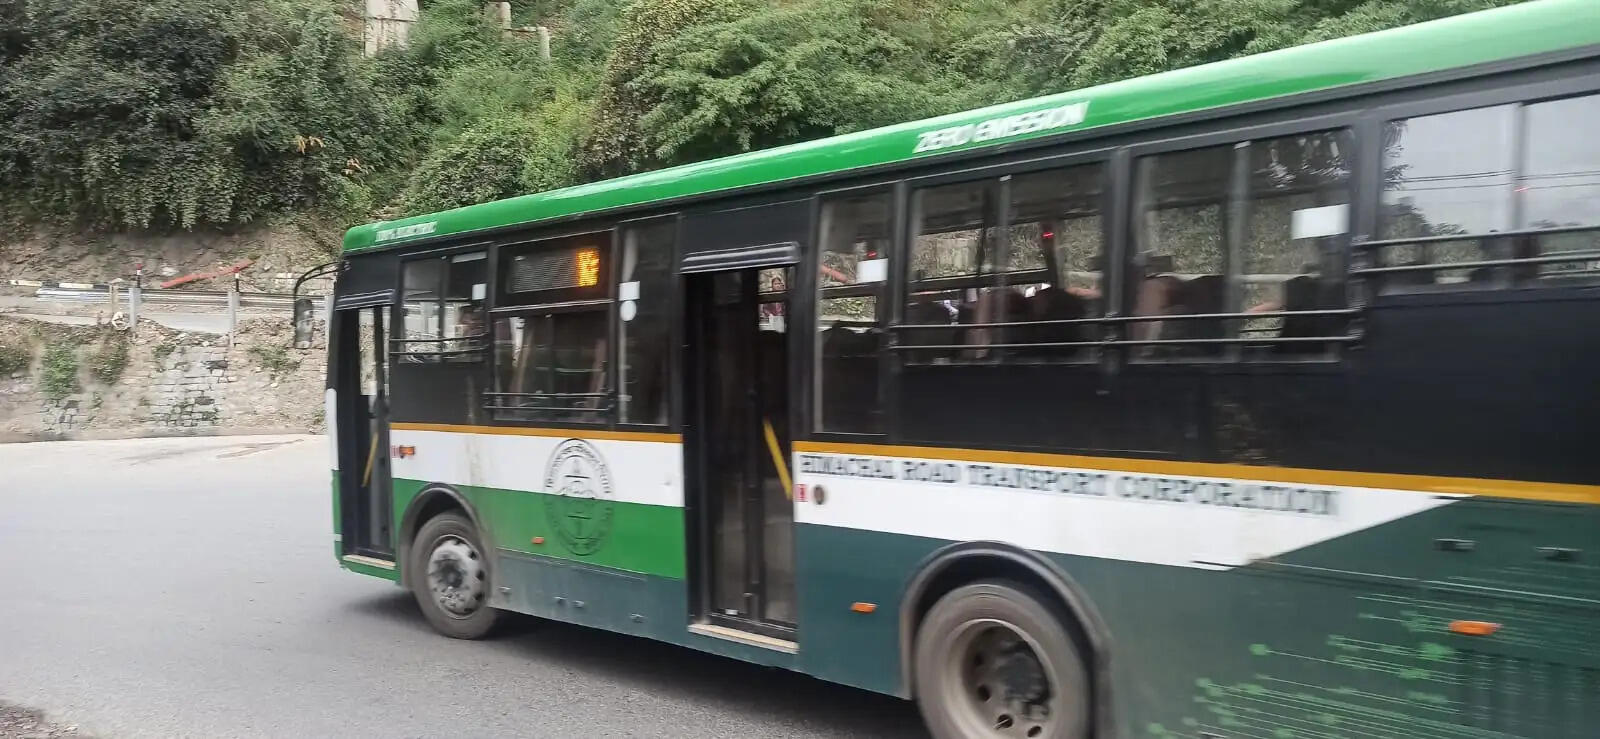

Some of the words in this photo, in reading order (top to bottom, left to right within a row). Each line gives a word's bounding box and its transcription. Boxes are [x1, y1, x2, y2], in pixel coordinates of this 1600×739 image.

[913, 124, 974, 153] ZERO
[800, 454, 896, 479] HIMACHAL
[902, 461, 962, 484] ROAD
[968, 464, 1107, 496] TRANSPORT
[1115, 475, 1339, 515] CORPORATION
